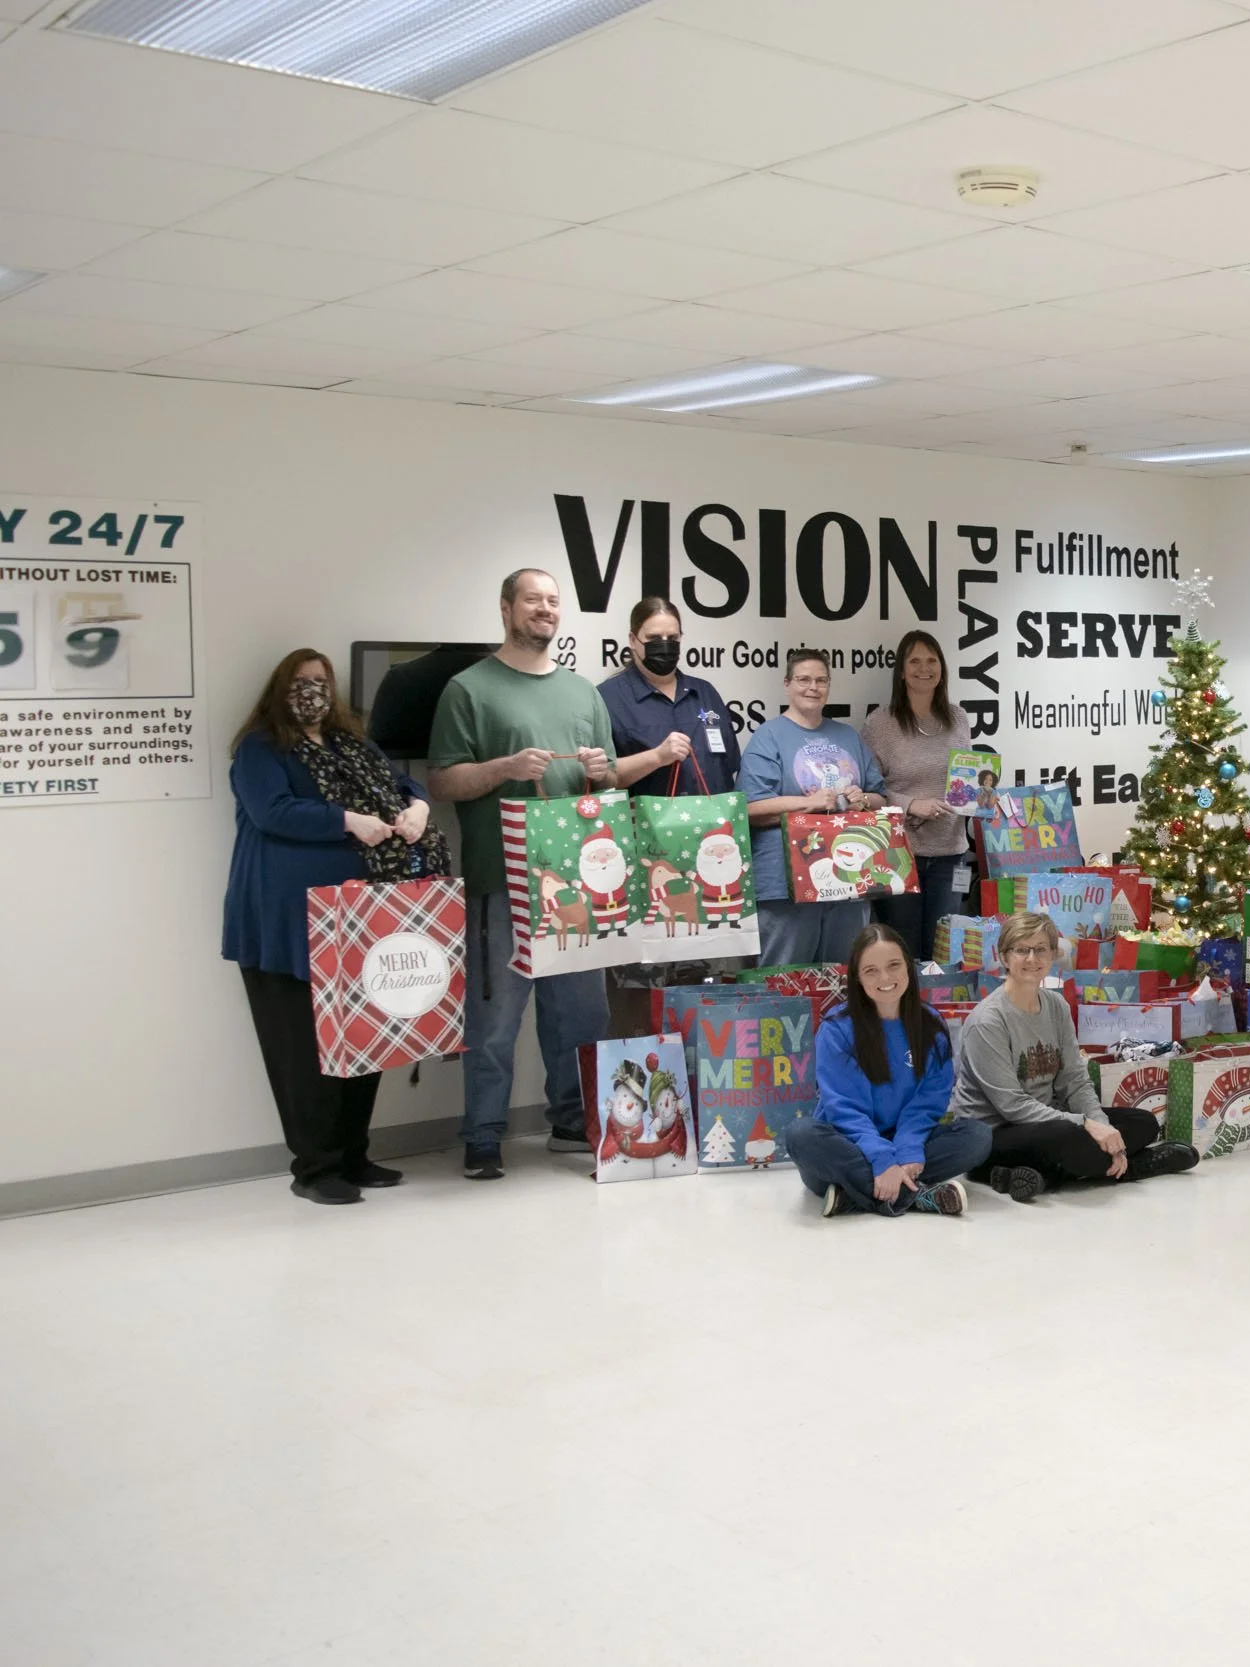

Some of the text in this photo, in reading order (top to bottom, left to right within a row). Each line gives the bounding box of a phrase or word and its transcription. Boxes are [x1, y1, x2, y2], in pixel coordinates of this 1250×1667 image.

[48, 510, 185, 556] 24/7
[553, 493, 939, 623] VISION
[1015, 529, 1180, 580] Fulfillment
[76, 569, 123, 583] LOST
[128, 570, 178, 584] TIME:
[957, 525, 1000, 753] PLAYB
[1016, 610, 1182, 658] SERVE
[65, 626, 121, 669] 9
[686, 645, 725, 669] our
[732, 640, 779, 668] God
[852, 642, 897, 674] pote
[18, 709, 54, 721] safe
[62, 708, 166, 721] environment
[174, 707, 192, 720] by
[1015, 690, 1126, 736] Meaningful
[0, 721, 193, 738] awareness and safety
[29, 741, 44, 752] of
[49, 742, 83, 754] your
[88, 736, 193, 751] surroundings,
[0, 752, 193, 770] or yourself and others.
[0, 778, 99, 794] ETY FIRST
[985, 821, 1073, 853] MERRY
[1038, 887, 1060, 907] HO
[1062, 895, 1083, 912] HO
[1084, 886, 1105, 905] HO
[1108, 924, 1134, 935] EASON
[378, 950, 429, 973] MERRY
[371, 971, 443, 993] Christmas
[700, 1014, 810, 1058] VERY
[700, 1052, 812, 1089] MERRY
[700, 1084, 816, 1108] CHRISTMAS
